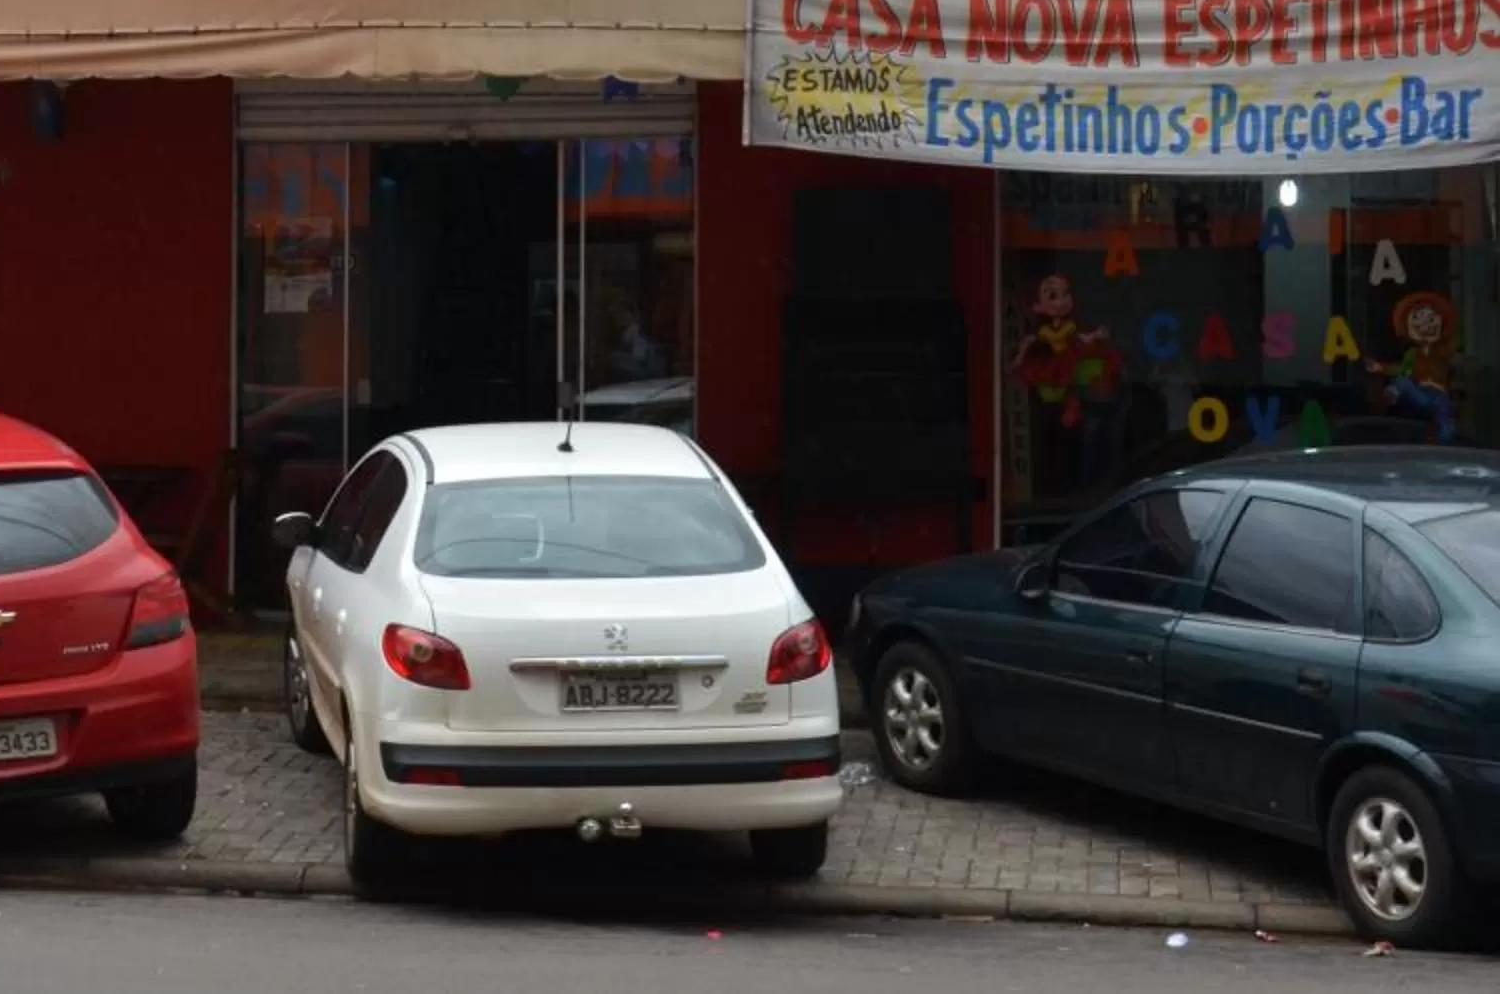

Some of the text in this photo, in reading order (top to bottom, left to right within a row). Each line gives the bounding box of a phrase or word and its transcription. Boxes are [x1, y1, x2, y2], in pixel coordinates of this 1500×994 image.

[782, 67, 891, 93] ESTAMOS
[795, 101, 900, 137] Atendendo
[926, 75, 1482, 164] Espetinhos Porções Bar
